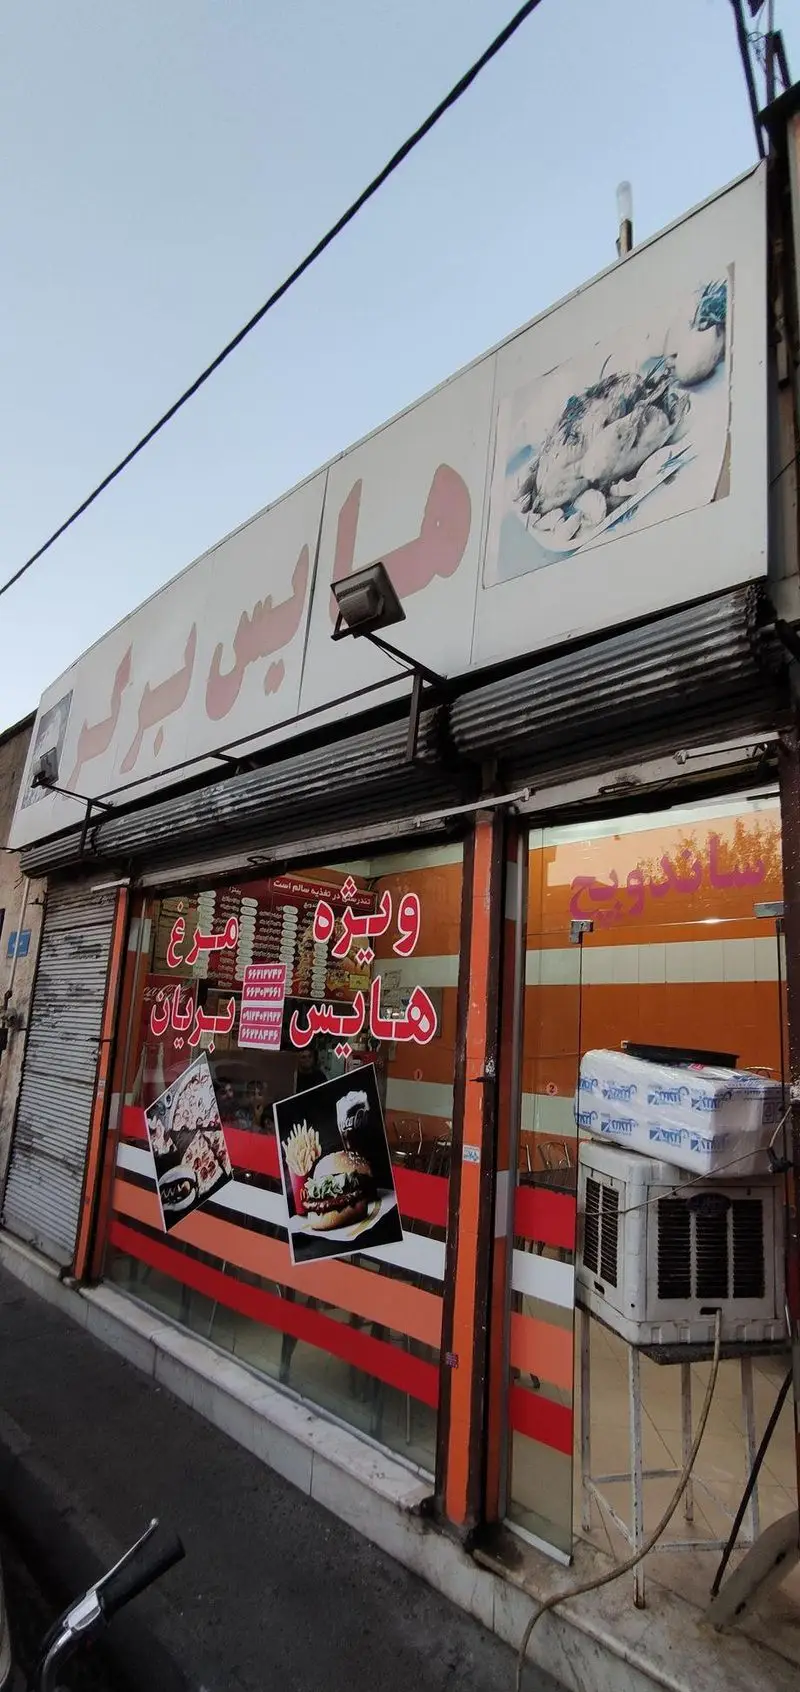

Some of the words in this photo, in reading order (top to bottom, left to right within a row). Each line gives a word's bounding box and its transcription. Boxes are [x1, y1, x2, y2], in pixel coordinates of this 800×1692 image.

[206, 463, 472, 721] هایس
[273, 879, 292, 890] است
[292, 883, 310, 893] سالم
[167, 900, 239, 968] مرغ
[312, 875, 421, 965] ویژه
[150, 984, 236, 1053] بریان
[290, 975, 438, 1059] هایس
